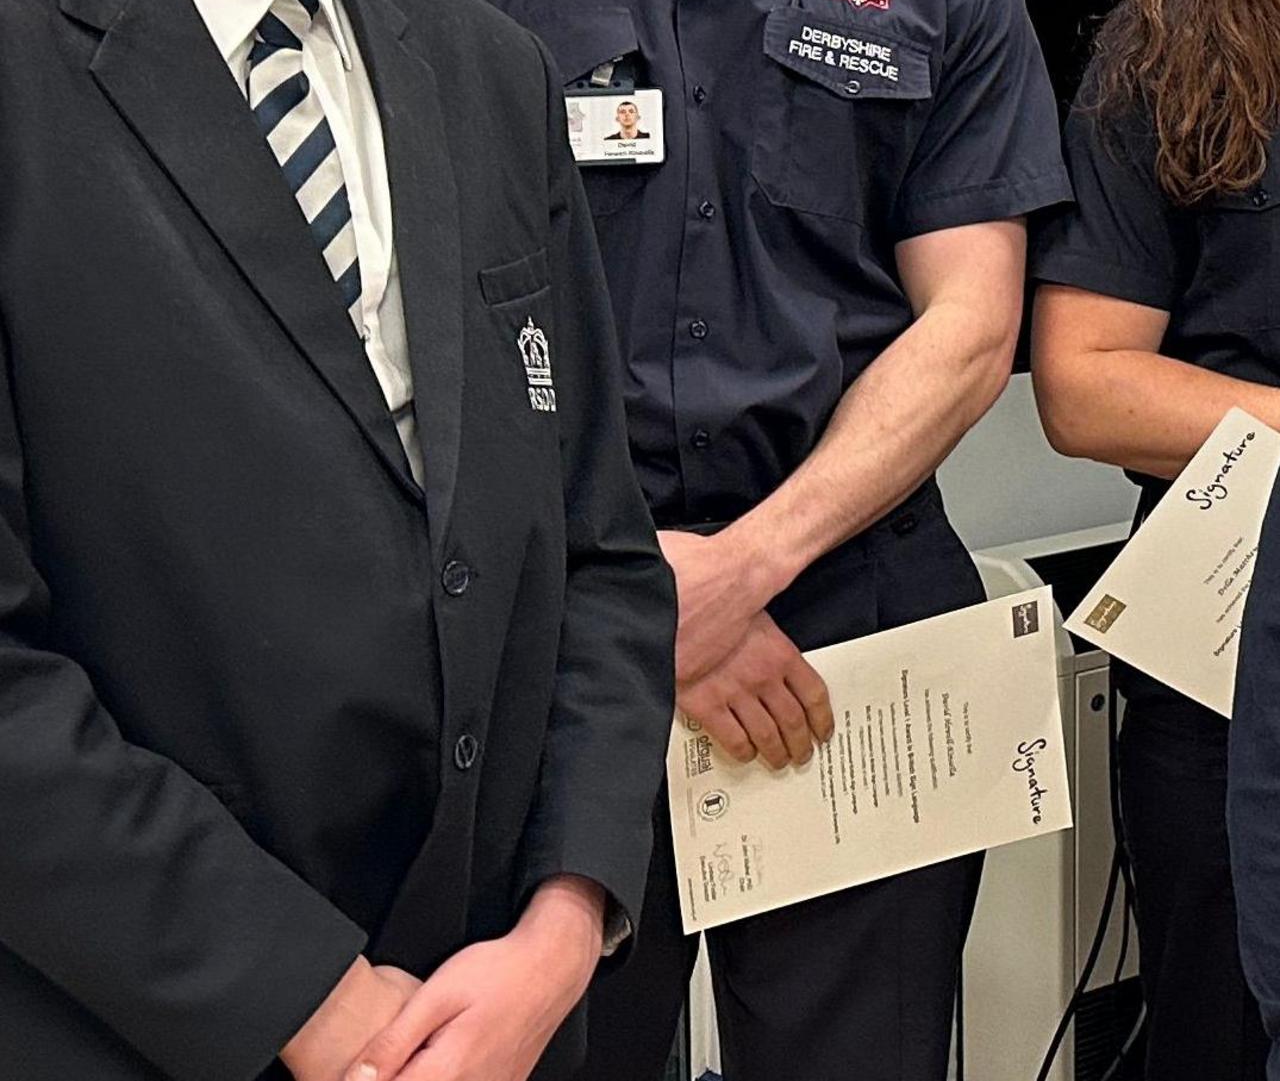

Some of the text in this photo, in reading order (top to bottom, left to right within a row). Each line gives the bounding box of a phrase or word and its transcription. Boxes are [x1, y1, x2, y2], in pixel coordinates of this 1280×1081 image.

[789, 40, 899, 82] FIRE & RESCUE
[800, 25, 892, 63] DERBYSHIRE
[1185, 431, 1256, 510] Signature
[1011, 737, 1047, 825] Signature
